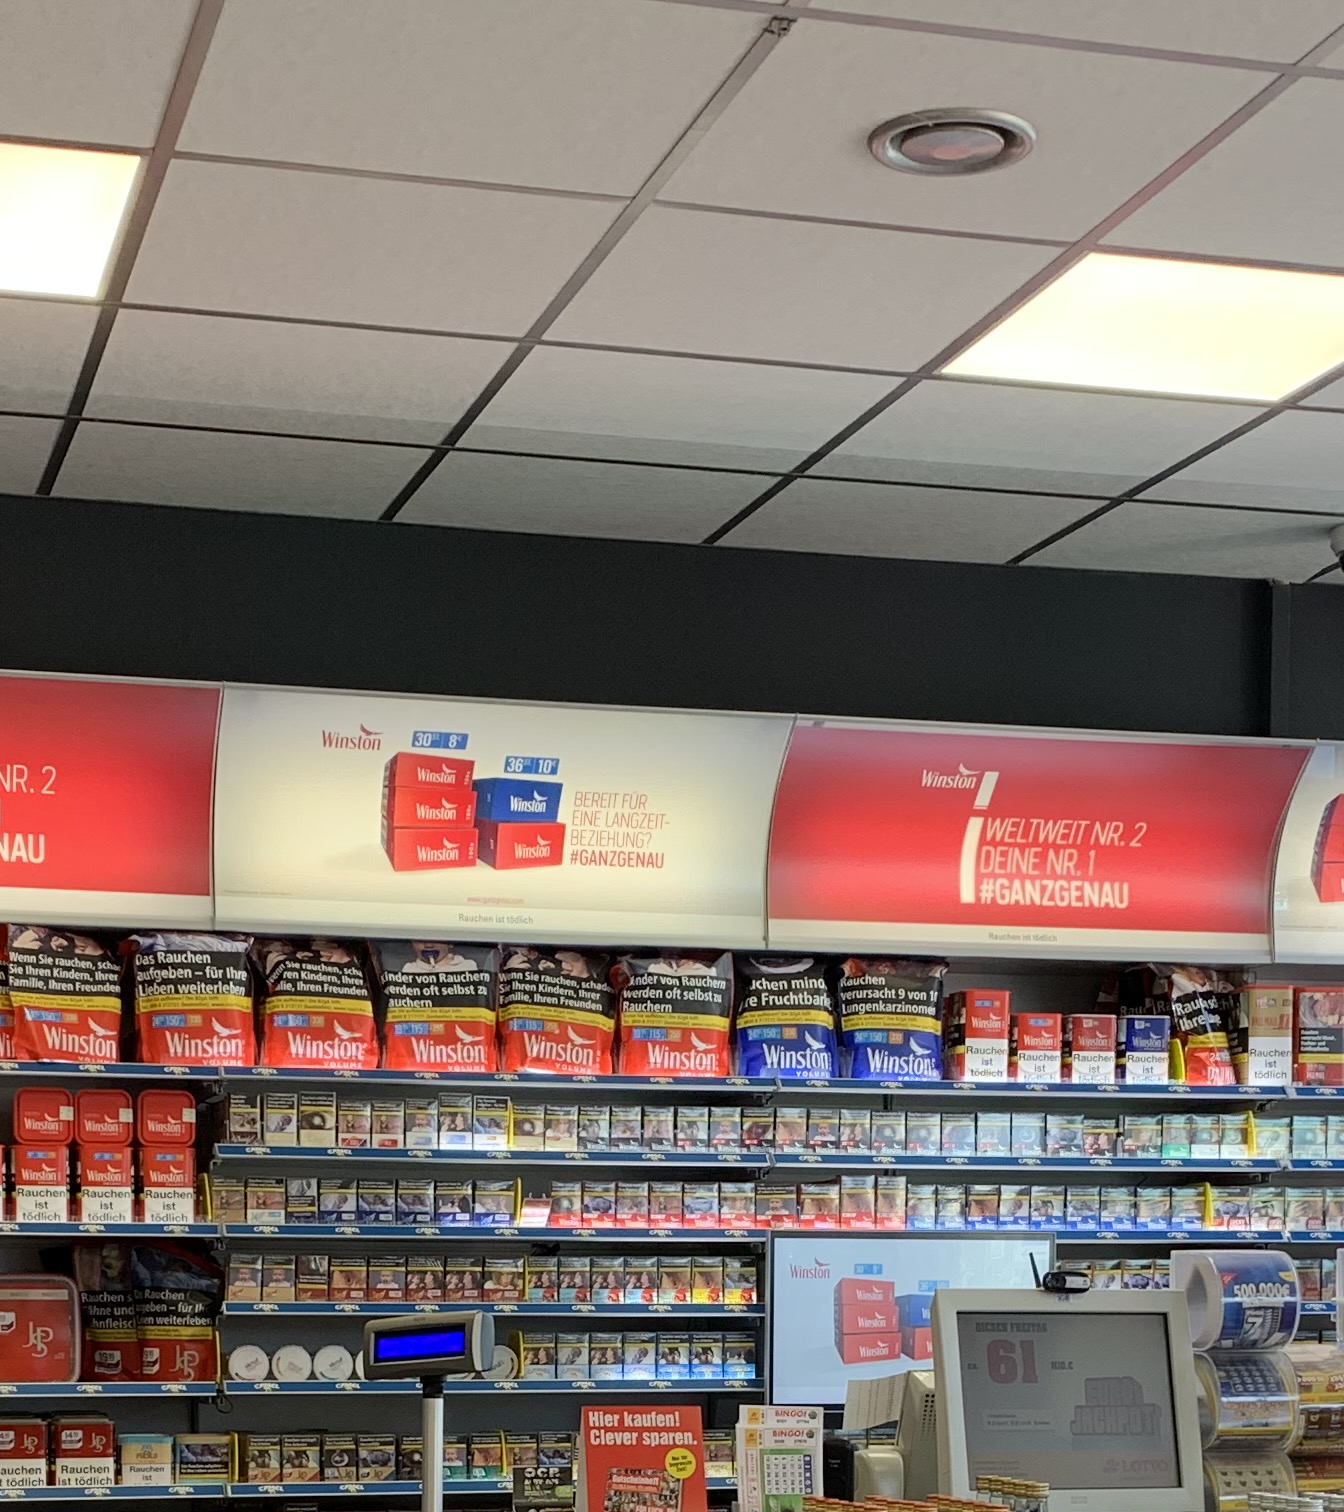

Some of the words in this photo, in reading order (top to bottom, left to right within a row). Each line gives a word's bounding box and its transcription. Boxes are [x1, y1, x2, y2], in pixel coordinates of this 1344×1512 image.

[321, 729, 381, 751] Winston
[40, 765, 57, 795] 2
[921, 770, 977, 789] Winston
[573, 791, 616, 810] BEREIT
[622, 791, 648, 811] FÜR
[572, 809, 600, 827] EINE
[605, 811, 670, 831] LANGZEIT-
[570, 829, 652, 850] BEZIEHUNG?
[986, 817, 1089, 845] WELTWEIT
[1091, 822, 1126, 848] NR.
[1130, 822, 1147, 848] 2
[570, 849, 665, 870] #GANZGENAU
[980, 846, 1040, 874] DEINE
[1047, 849, 1083, 876] NR.
[1088, 851, 1095, 876] 1
[980, 878, 1129, 909] #GANZGENAU
[458, 913, 492, 924] Rauchen
[495, 914, 505, 925] ist
[507, 915, 534, 926] tödlich
[9, 952, 35, 963] Wenn
[38, 953, 53, 965] Sie
[55, 956, 97, 970] rauchen,
[157, 952, 211, 964] Rauchen
[42, 1024, 117, 1057] Winston
[763, 1044, 828, 1069] Winston
[987, 1339, 1039, 1384] 61
[588, 1411, 620, 1427] Hier
[623, 1411, 680, 1427] kaufen!
[590, 1429, 638, 1445] Clever
[642, 1431, 697, 1447] sparen.
